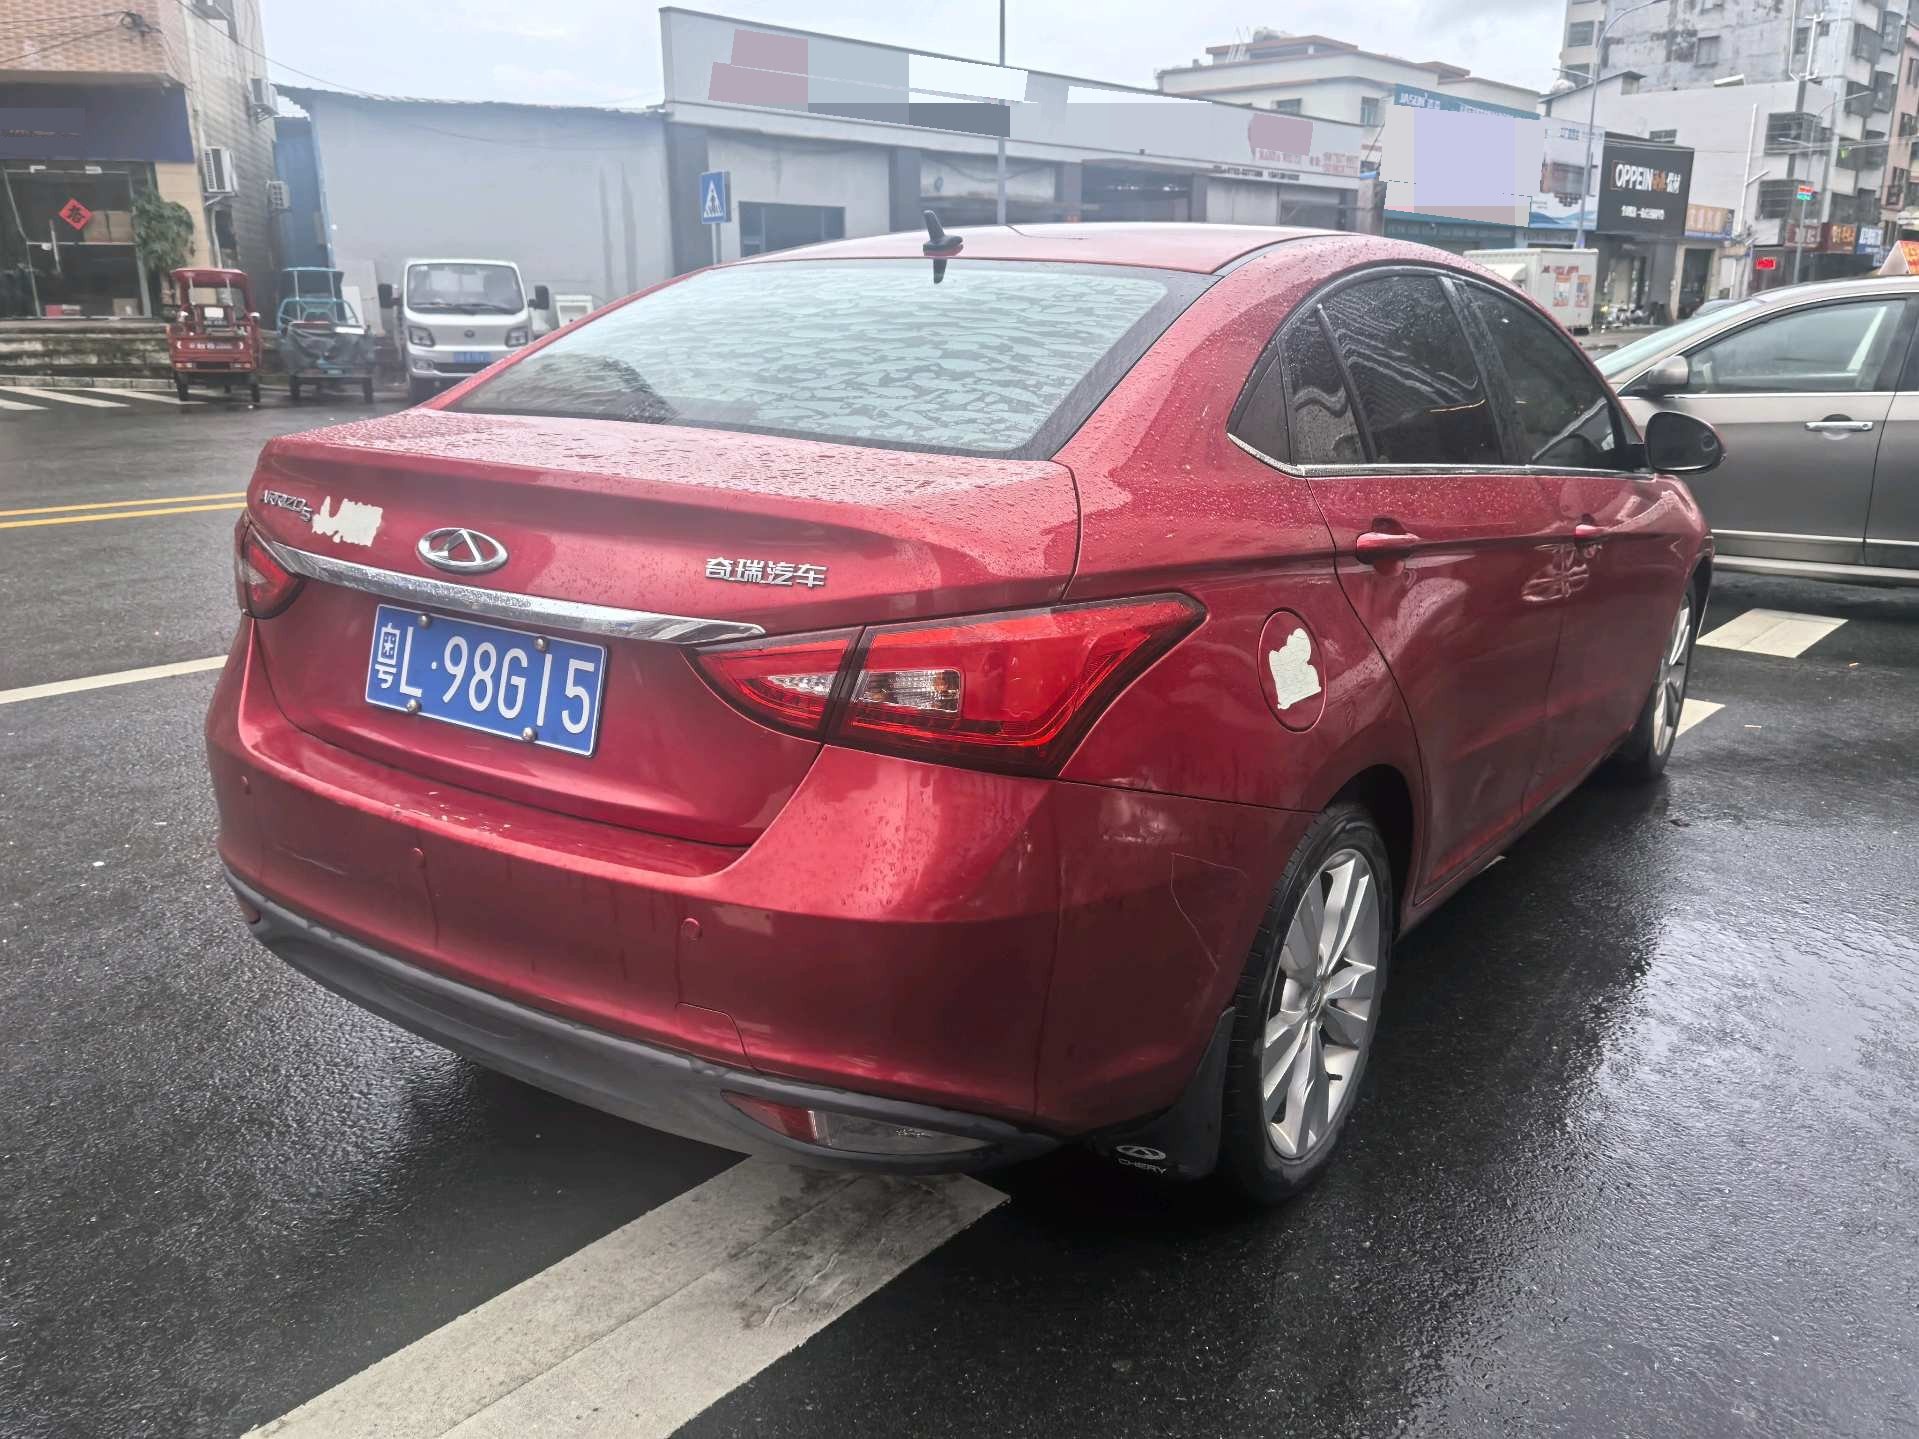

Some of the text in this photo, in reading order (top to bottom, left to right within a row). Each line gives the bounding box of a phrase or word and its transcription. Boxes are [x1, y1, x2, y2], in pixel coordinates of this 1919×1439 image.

[1615, 163, 1654, 192] OPPEIN
[705, 556, 828, 588] 奇瑞汽车
[1118, 1158, 1167, 1174] CHERY
